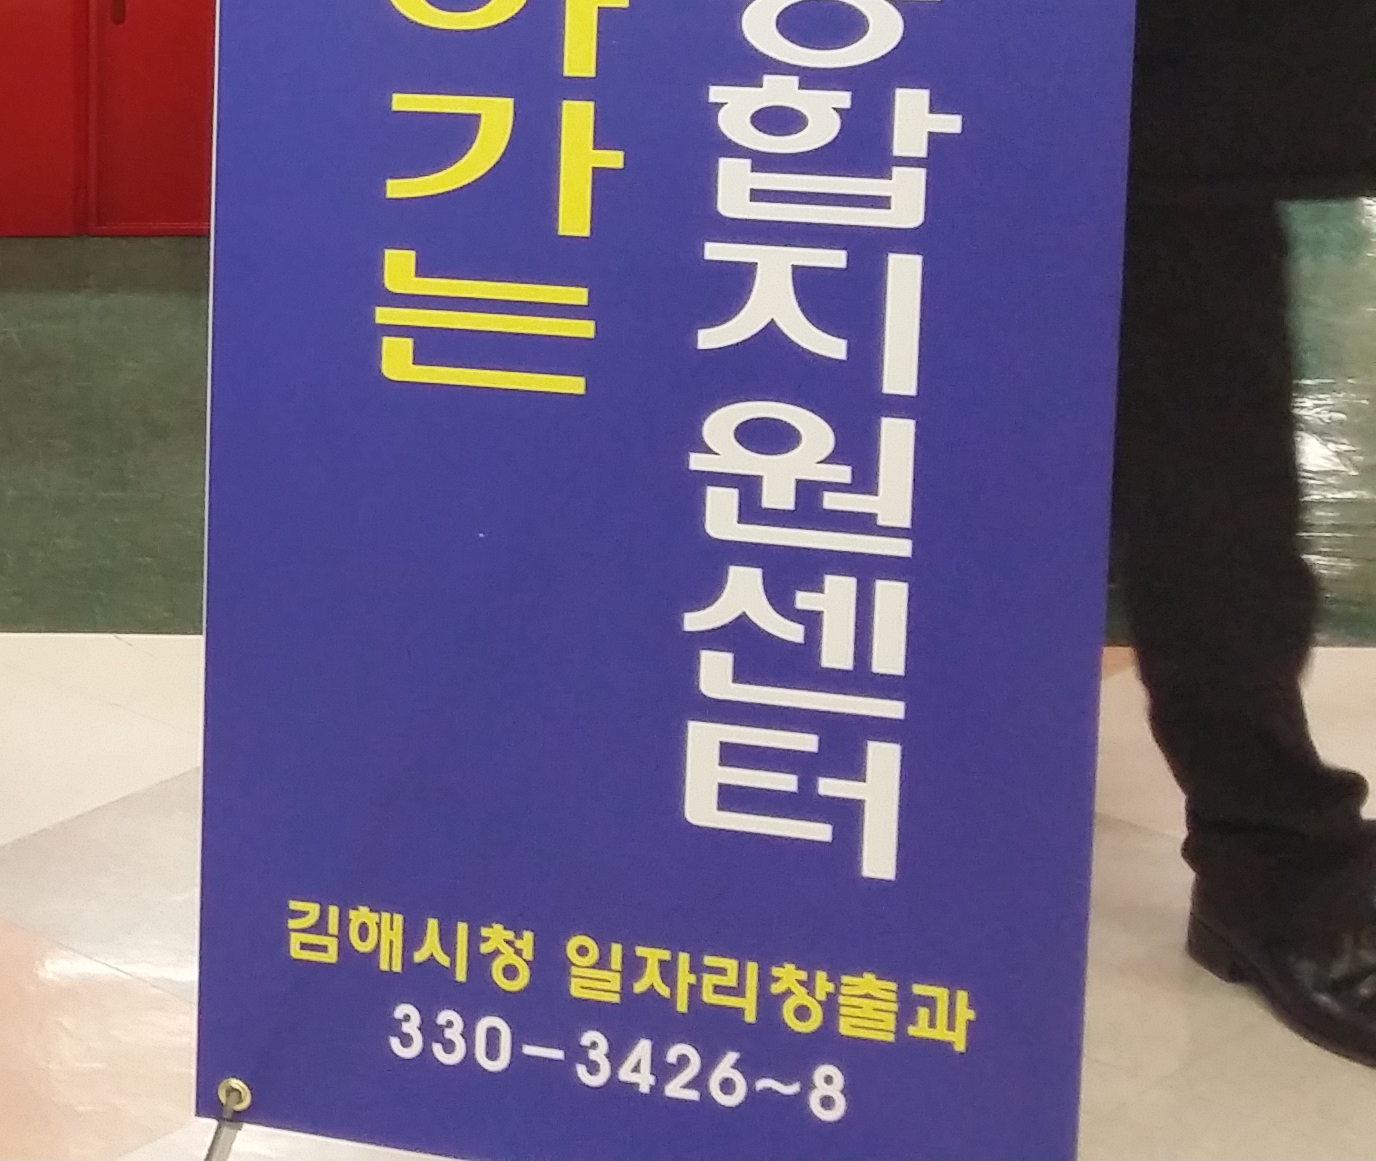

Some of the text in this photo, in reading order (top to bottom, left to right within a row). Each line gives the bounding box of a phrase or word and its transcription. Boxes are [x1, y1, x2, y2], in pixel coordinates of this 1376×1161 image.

[286, 899, 977, 1053] 김해시청 일자리창출과
[388, 1002, 849, 1124] 330-3426~8
